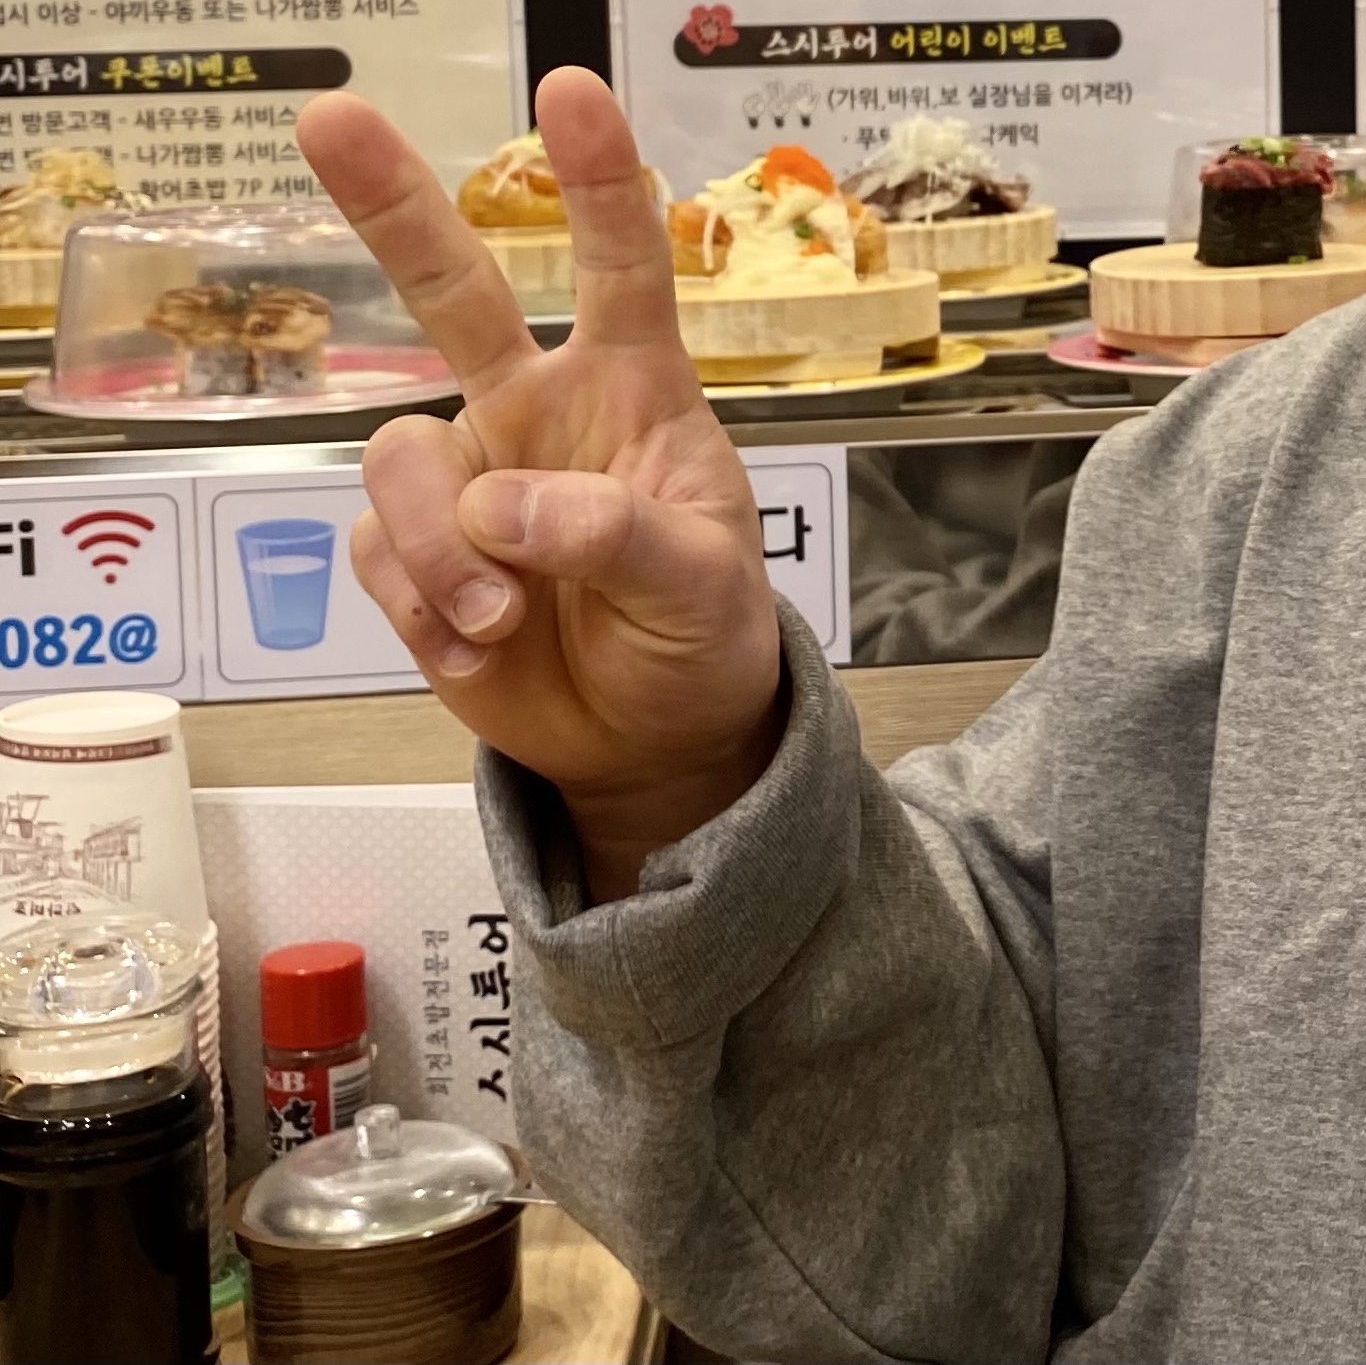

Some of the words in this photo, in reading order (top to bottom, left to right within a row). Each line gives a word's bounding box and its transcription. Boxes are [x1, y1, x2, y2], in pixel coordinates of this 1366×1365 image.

[0, 2, 29, 28] 시
[37, 0, 82, 27] 이상
[760, 26, 877, 59] 스시투어
[889, 24, 971, 57] 어린이
[983, 22, 1067, 55] 이벤트
[100, 52, 258, 90] 쿠폰이벤트
[968, 83, 1052, 108] 실장님을
[1061, 81, 1134, 105] 이겨라)
[21, 109, 112, 135] 방문고객
[135, 105, 224, 130] 새우우동
[232, 104, 298, 129] 서비스
[234, 140, 302, 164] 서비스
[233, 177, 264, 198] 7P
[422, 930, 452, 1095] 회전초밥전문점
